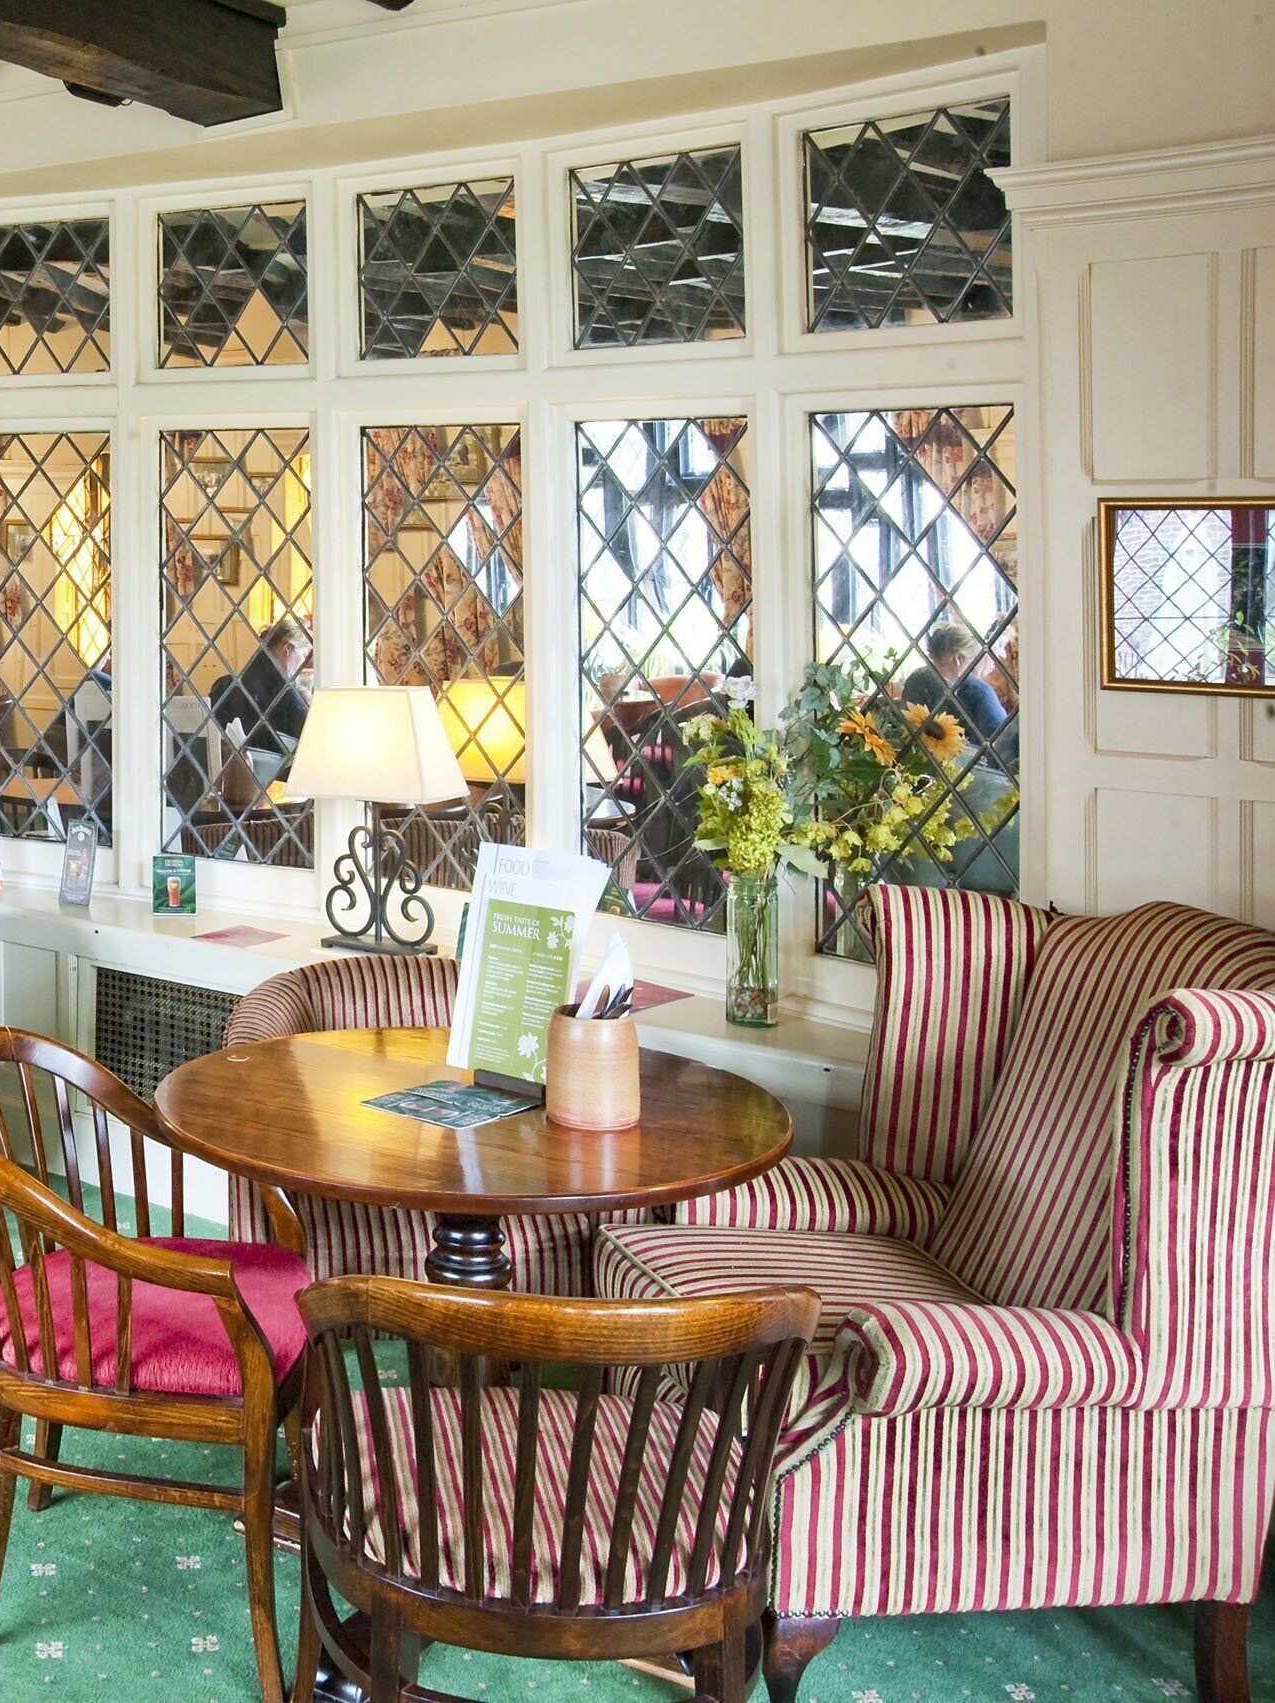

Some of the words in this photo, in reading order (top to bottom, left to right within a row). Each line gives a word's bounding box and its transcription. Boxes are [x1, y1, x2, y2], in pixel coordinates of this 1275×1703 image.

[498, 857, 531, 877] FOOD
[488, 877, 518, 897] WINE
[493, 912, 512, 923] FRESH
[512, 915, 531, 926] TASTE
[492, 920, 541, 940] SUMMER
